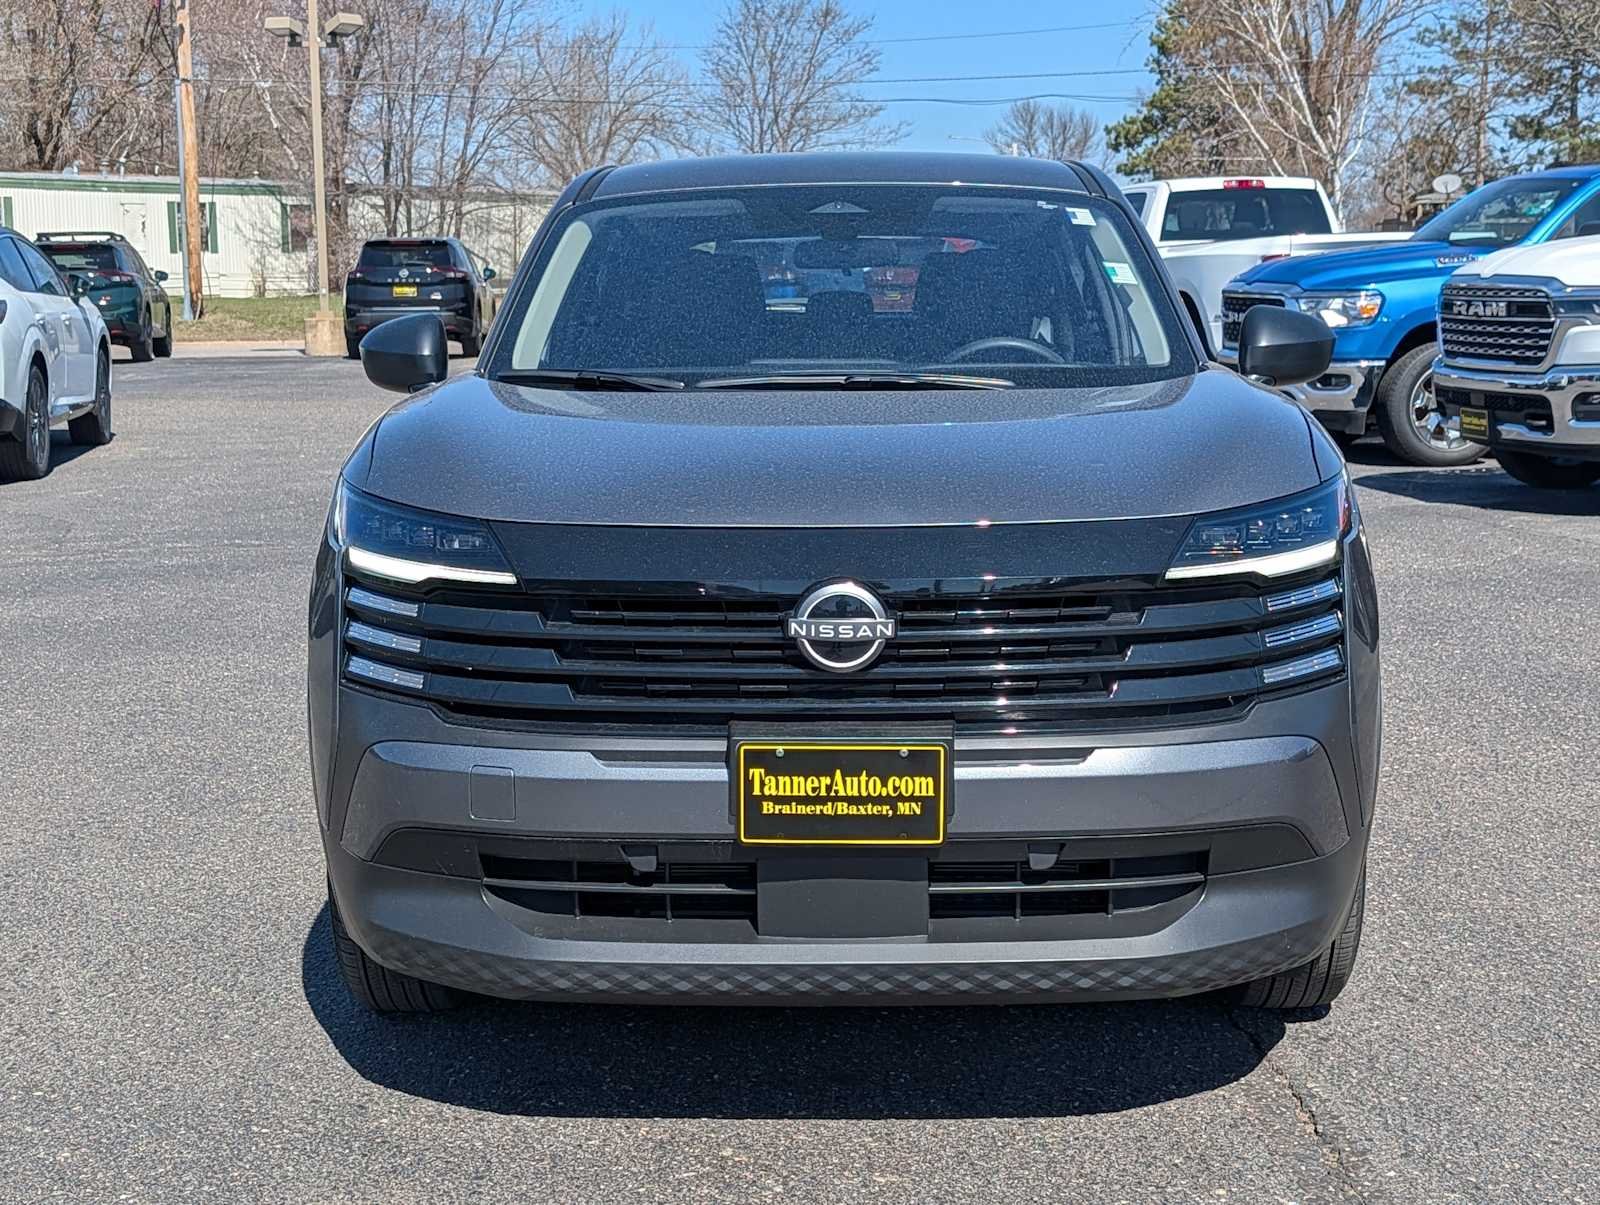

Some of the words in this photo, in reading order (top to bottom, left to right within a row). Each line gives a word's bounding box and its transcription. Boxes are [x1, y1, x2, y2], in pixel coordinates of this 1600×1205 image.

[1453, 301, 1508, 317] RAM
[790, 622, 893, 638] NISSAN
[748, 768, 935, 797] TannerAuto.com
[762, 801, 893, 817] Brainerd/Baxter,
[897, 802, 922, 815] MN
